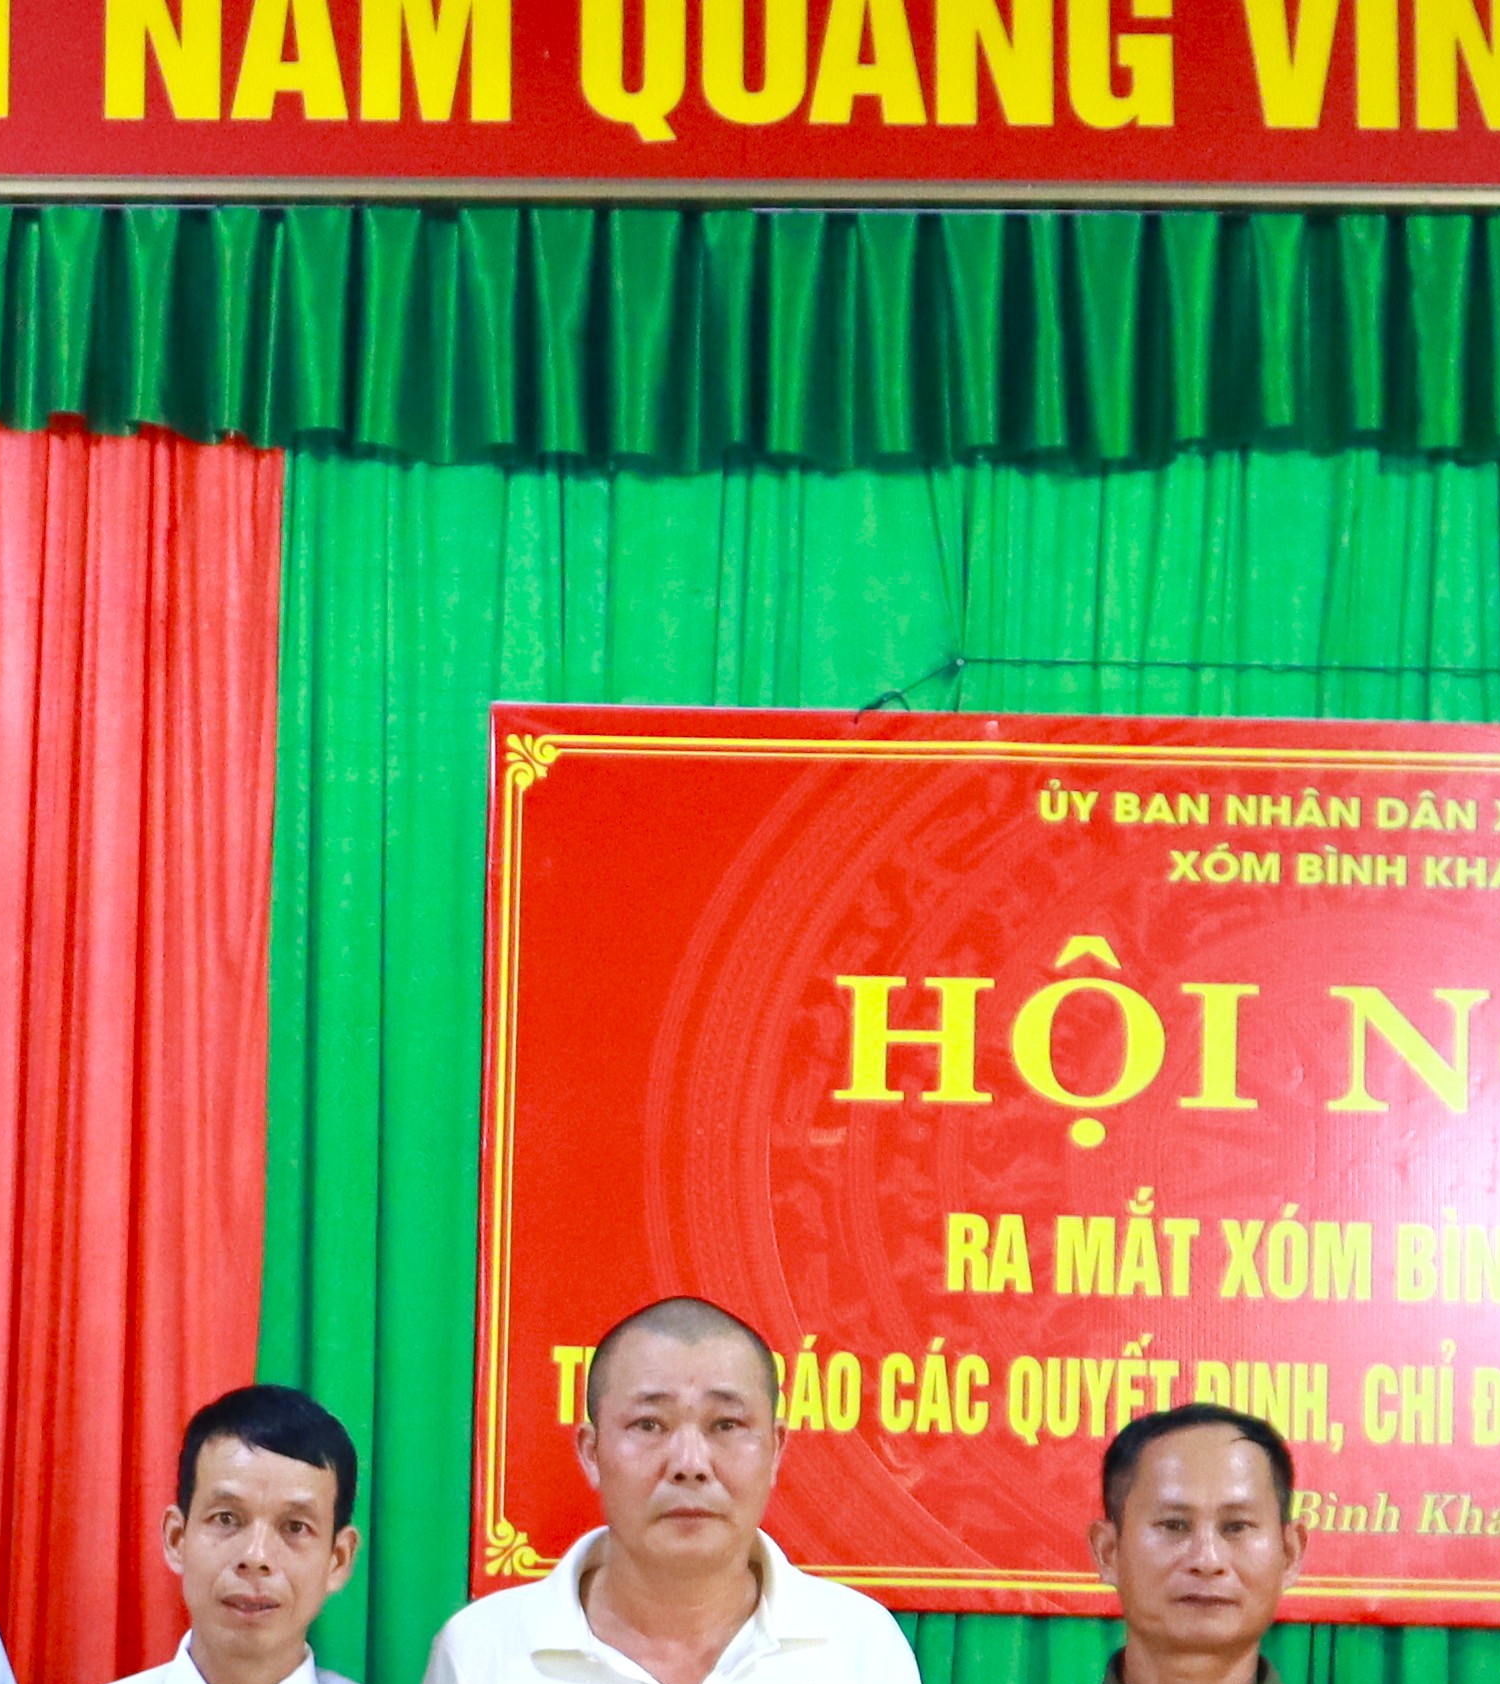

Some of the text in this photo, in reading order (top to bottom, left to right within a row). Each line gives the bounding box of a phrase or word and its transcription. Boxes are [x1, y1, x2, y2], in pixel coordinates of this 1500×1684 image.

[103, 0, 513, 123] NAM
[580, 0, 1175, 143] QUANG
[1039, 778, 1099, 823] ỦY
[1114, 791, 1210, 825] BAN
[1226, 787, 1361, 828] NHÂN
[1376, 789, 1478, 831] DÂN
[1169, 842, 1280, 884] XÓM
[1297, 844, 1407, 887] BÌNH
[833, 934, 1261, 1149] HỘI
[945, 1212, 1033, 1296] RA
[1054, 1187, 1200, 1298] MẮT
[1219, 1204, 1373, 1301] XÓM
[881, 1336, 990, 1435] CÁC
[1008, 1333, 1180, 1446] QUYẾT
[1364, 1338, 1456, 1445] CHỈ
[1289, 1490, 1401, 1533] Bình
